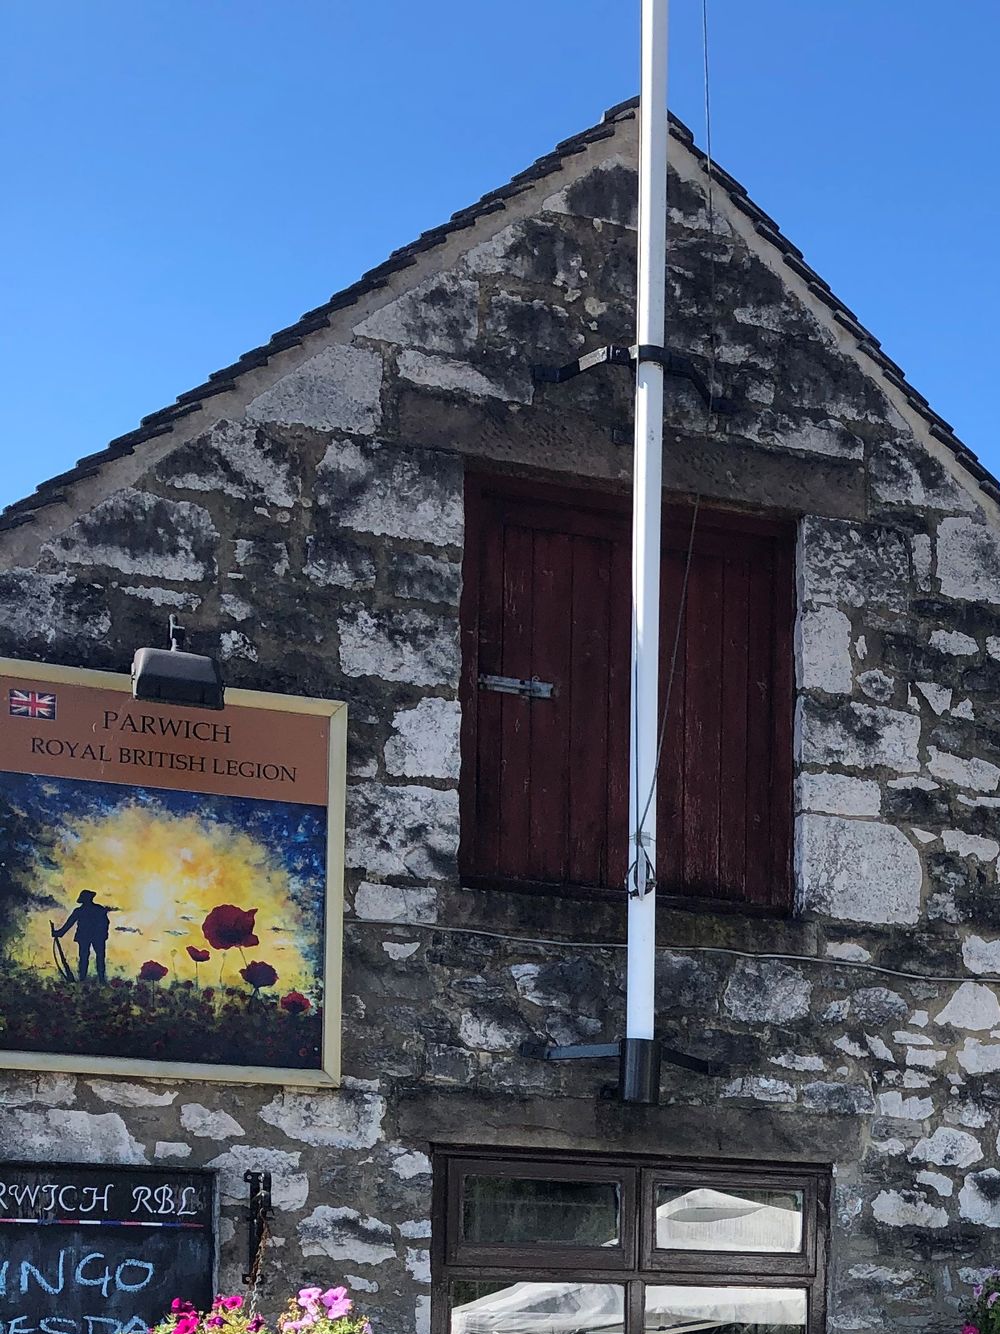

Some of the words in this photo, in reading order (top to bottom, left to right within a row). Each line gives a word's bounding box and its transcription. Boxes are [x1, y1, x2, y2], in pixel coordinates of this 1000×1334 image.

[103, 710, 231, 744] PARWICH
[31, 737, 112, 762] ROYAL
[119, 748, 205, 773] BRITISH
[213, 758, 297, 783] LEGION
